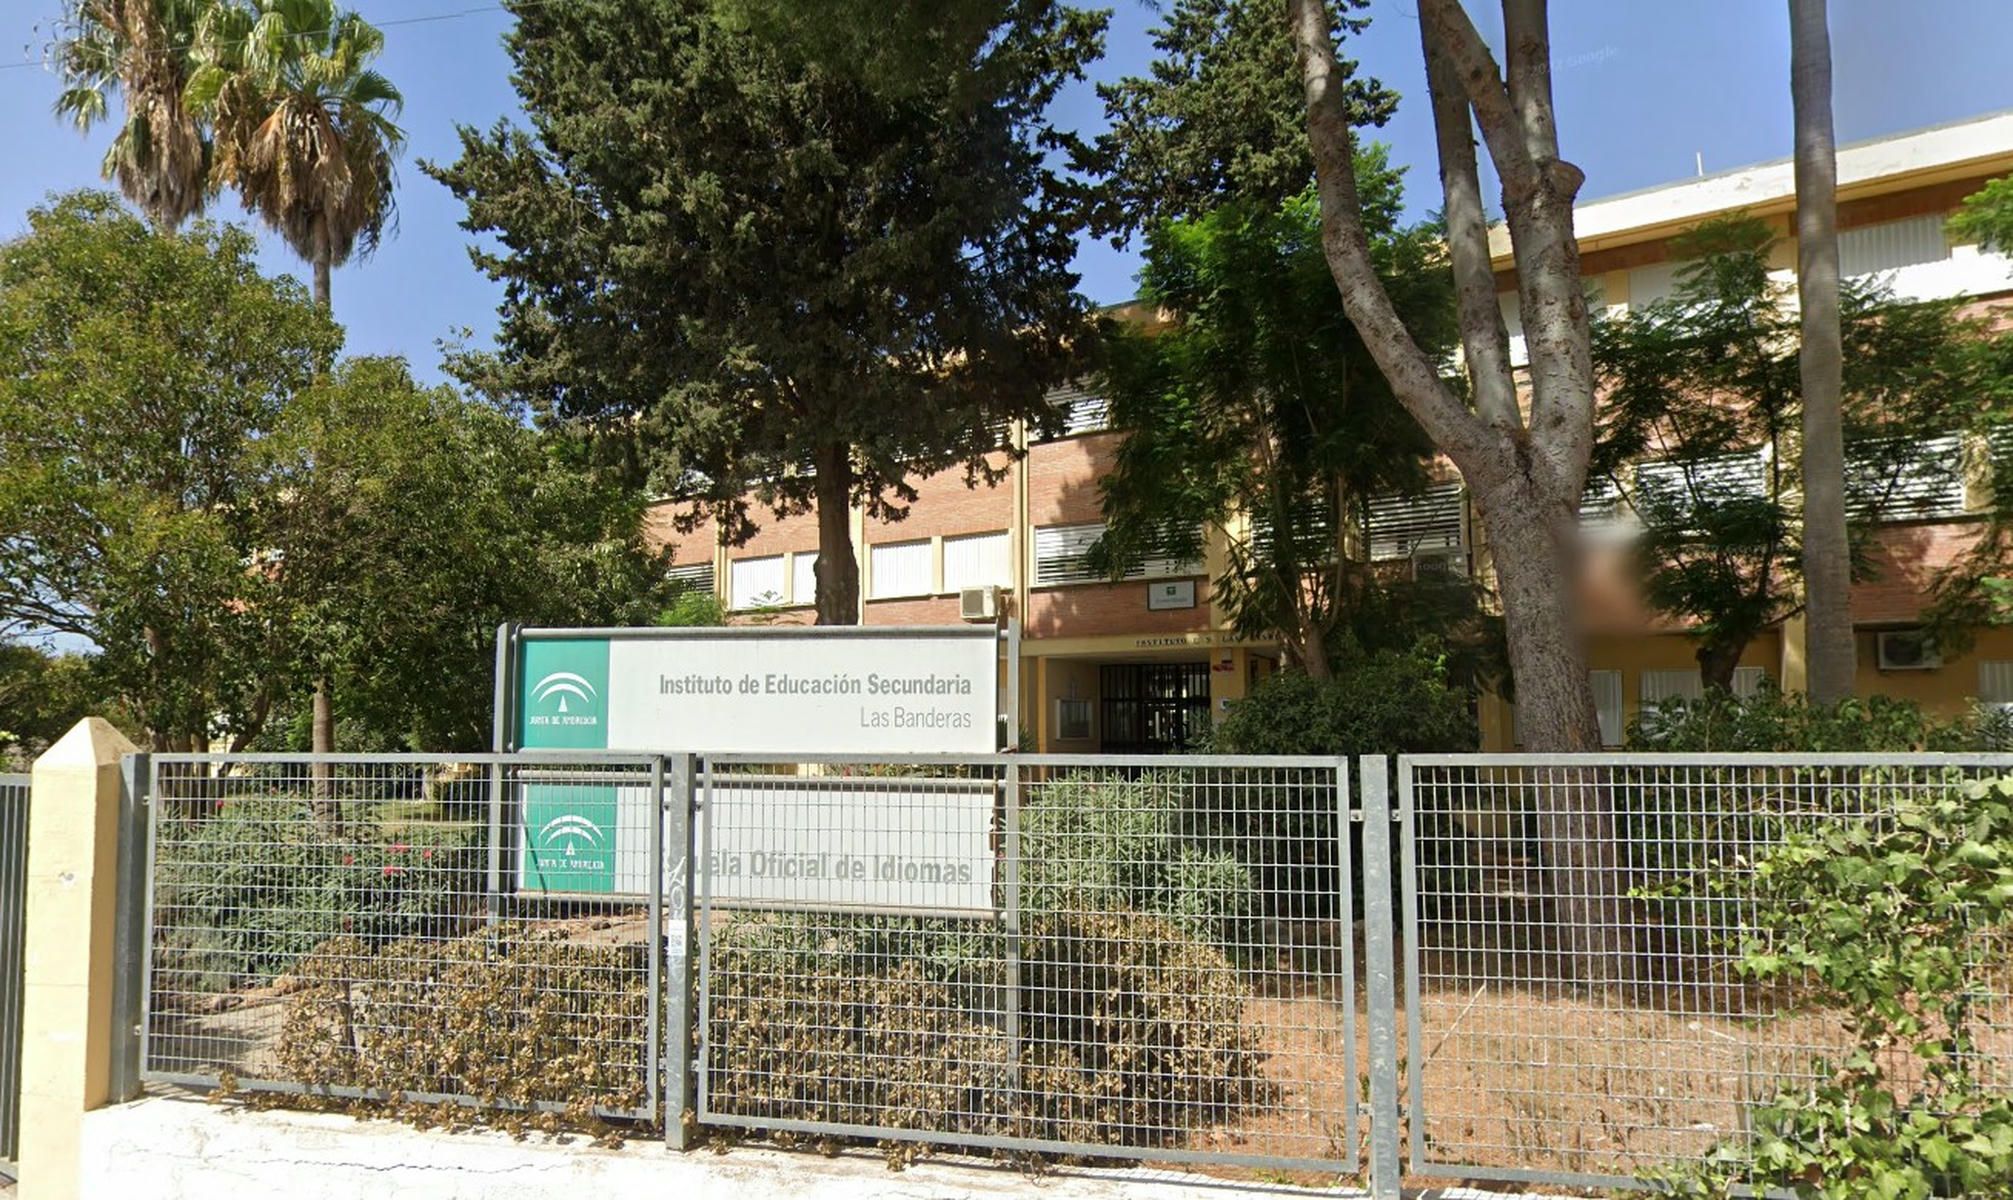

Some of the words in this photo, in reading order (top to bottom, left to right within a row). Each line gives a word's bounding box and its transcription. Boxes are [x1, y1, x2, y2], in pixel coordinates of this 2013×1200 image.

[659, 674, 733, 694] Instituto
[738, 674, 760, 694] de
[765, 674, 862, 694] Educación
[867, 673, 972, 694] Secundaria
[860, 706, 890, 728] Las
[894, 706, 972, 728] Banderas
[749, 849, 827, 878] Oficial
[835, 854, 866, 881] de
[873, 854, 972, 884] Idiomas
